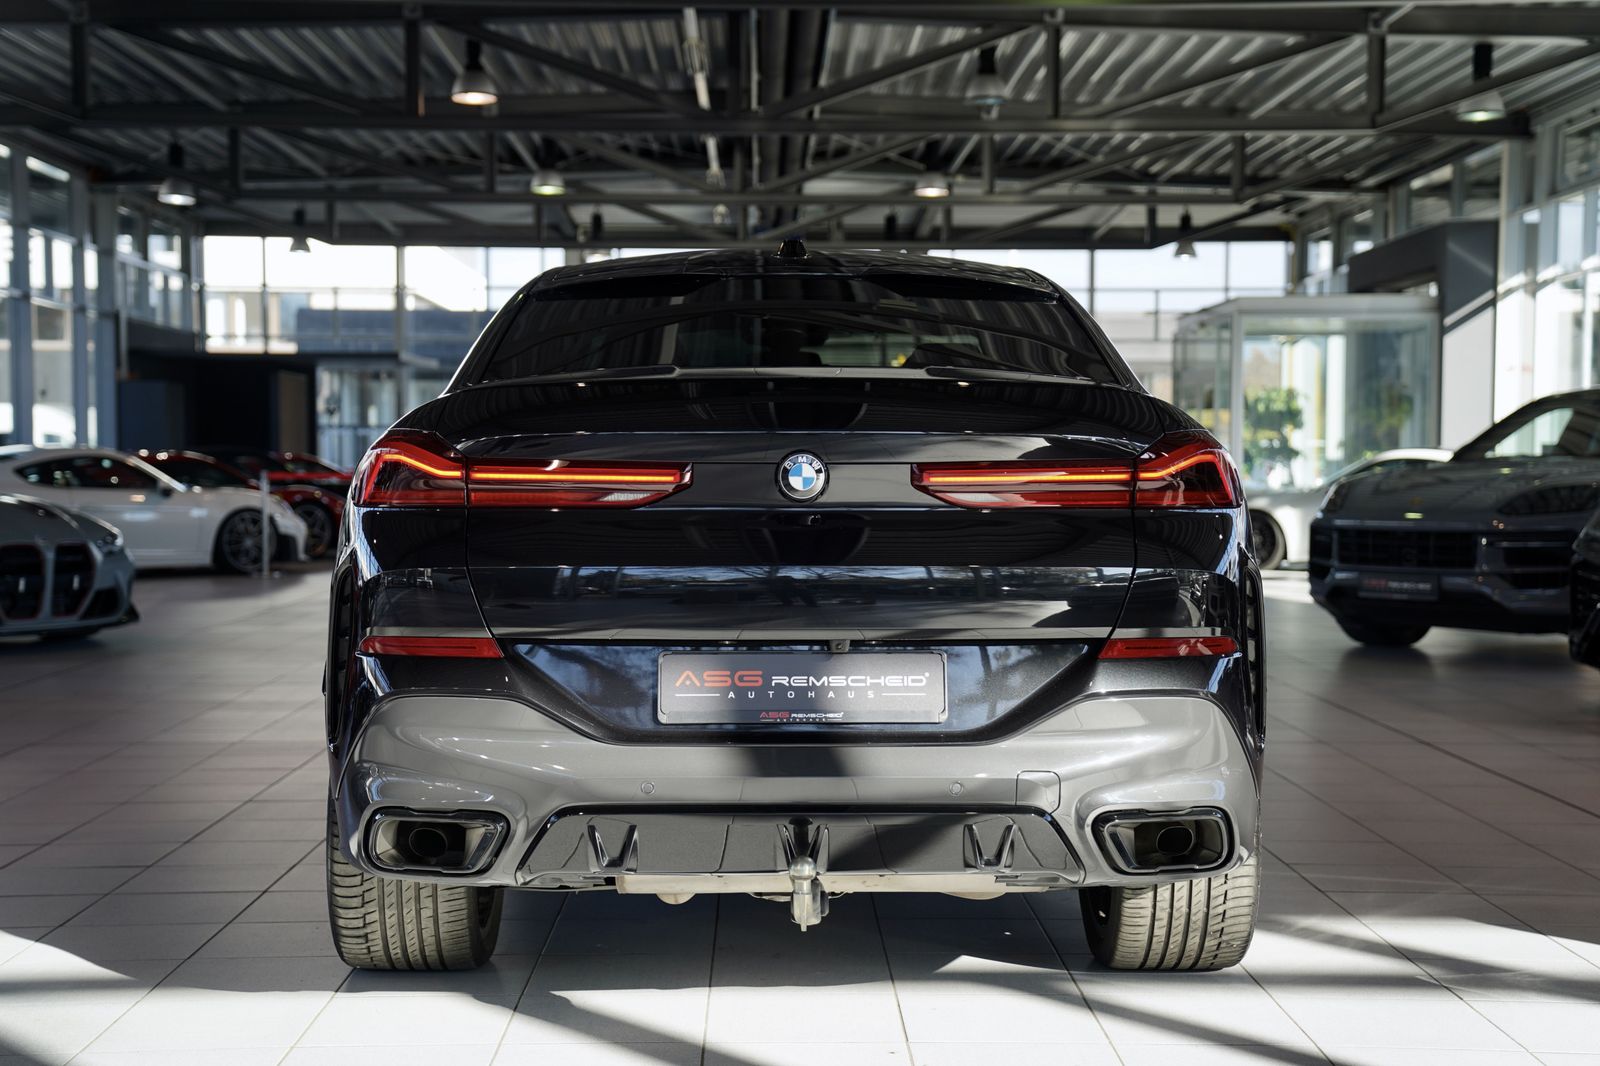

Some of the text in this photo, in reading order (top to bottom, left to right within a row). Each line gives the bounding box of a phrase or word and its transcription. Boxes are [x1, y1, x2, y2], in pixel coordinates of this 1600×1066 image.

[784, 456, 821, 470] BMW
[675, 671, 926, 687] ASG REMSCHEID
